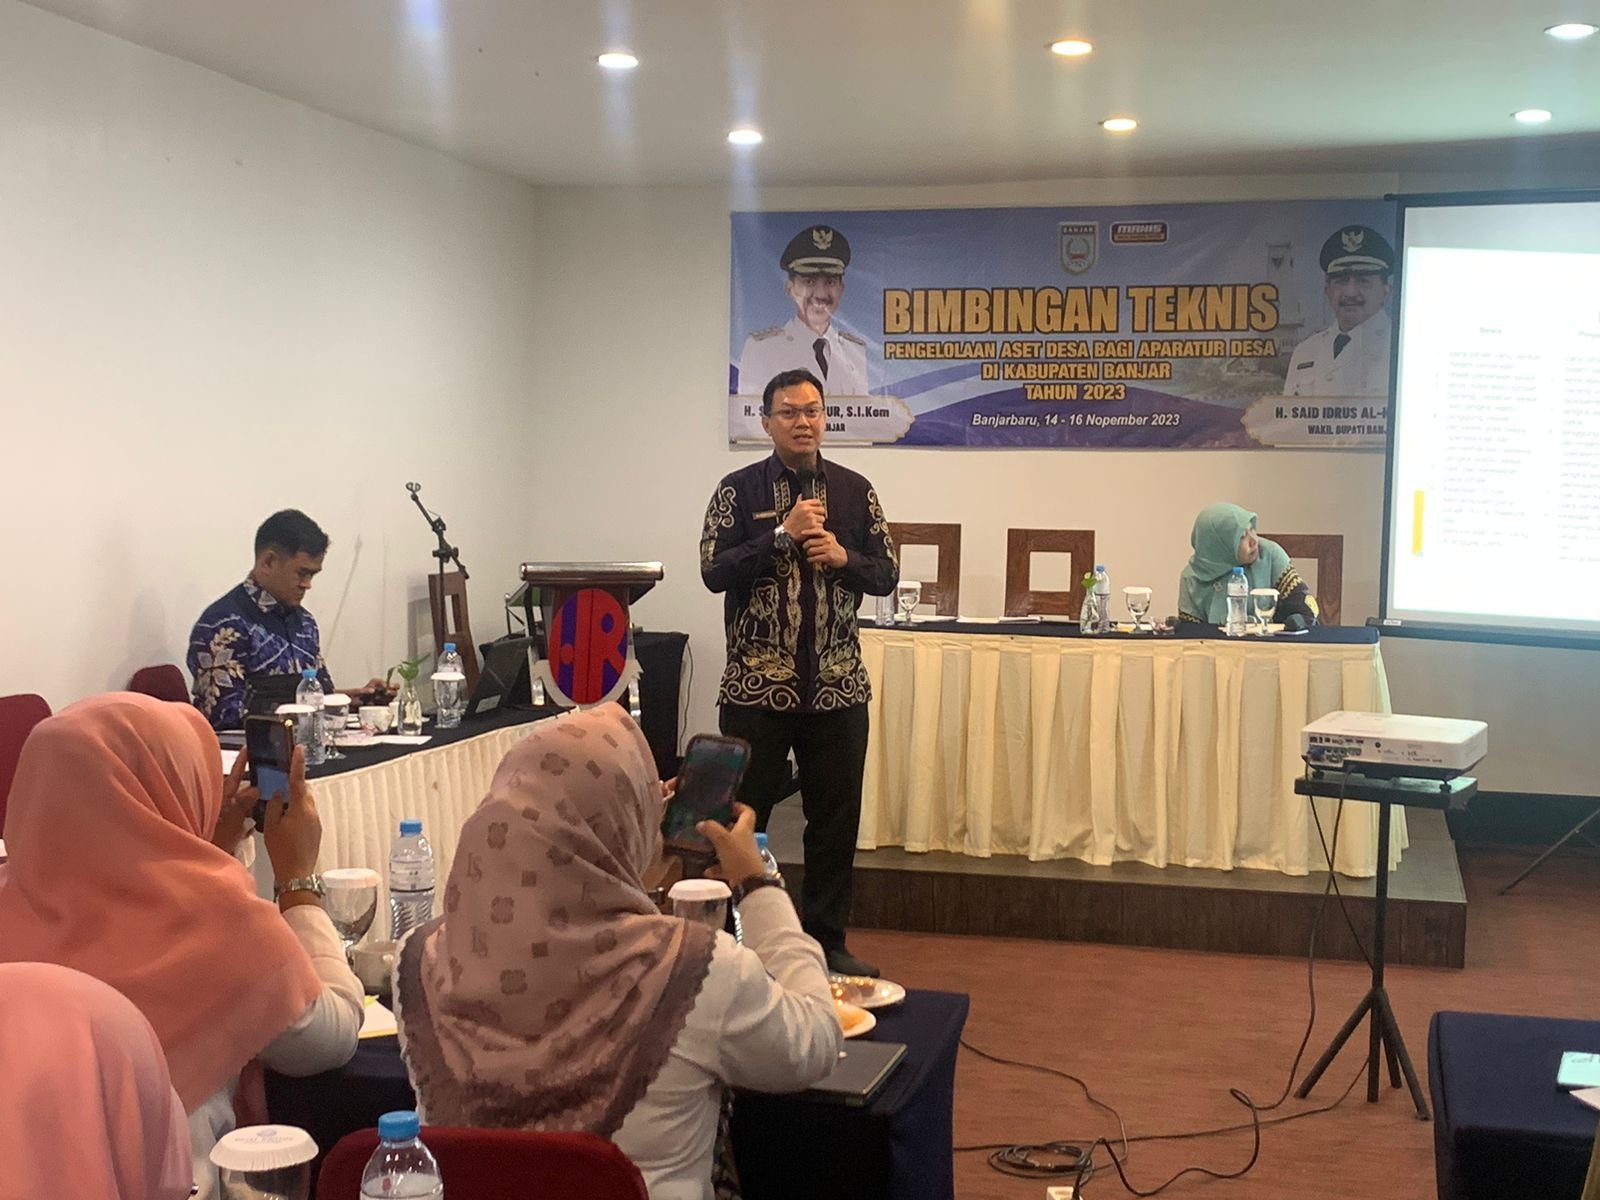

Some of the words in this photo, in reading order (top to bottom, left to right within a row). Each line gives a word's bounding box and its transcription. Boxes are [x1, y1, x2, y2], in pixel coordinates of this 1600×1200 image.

[884, 287, 1120, 334] BIMBINGAN
[1126, 283, 1279, 332] TEKNIS
[884, 341, 997, 360] PENGELOLAAN
[999, 341, 1043, 359] ASET
[1046, 341, 1092, 359] DESA
[1093, 340, 1134, 358] BAGI
[1137, 339, 1226, 358] APARATUR
[1229, 338, 1277, 358] DESA
[981, 361, 1000, 380] DI
[1002, 361, 1100, 380] KABUPATEN
[1102, 361, 1173, 380] BANJAR
[1023, 383, 1079, 401] TAHUN
[1083, 383, 1127, 401] 2023
[744, 405, 756, 416] H.
[846, 406, 890, 417] S.I.Kom
[1275, 407, 1288, 419] H.
[1291, 407, 1320, 419] SAID
[1322, 407, 1358, 419] IDRUS
[972, 414, 1040, 428] Banjarbaru,
[1044, 414, 1060, 425] 14
[1068, 414, 1083, 425] 16
[1085, 414, 1148, 428] Nopember
[1150, 414, 1180, 426] 2023
[1307, 425, 1333, 434] WAKIL
[1335, 425, 1365, 434] BUPATI
